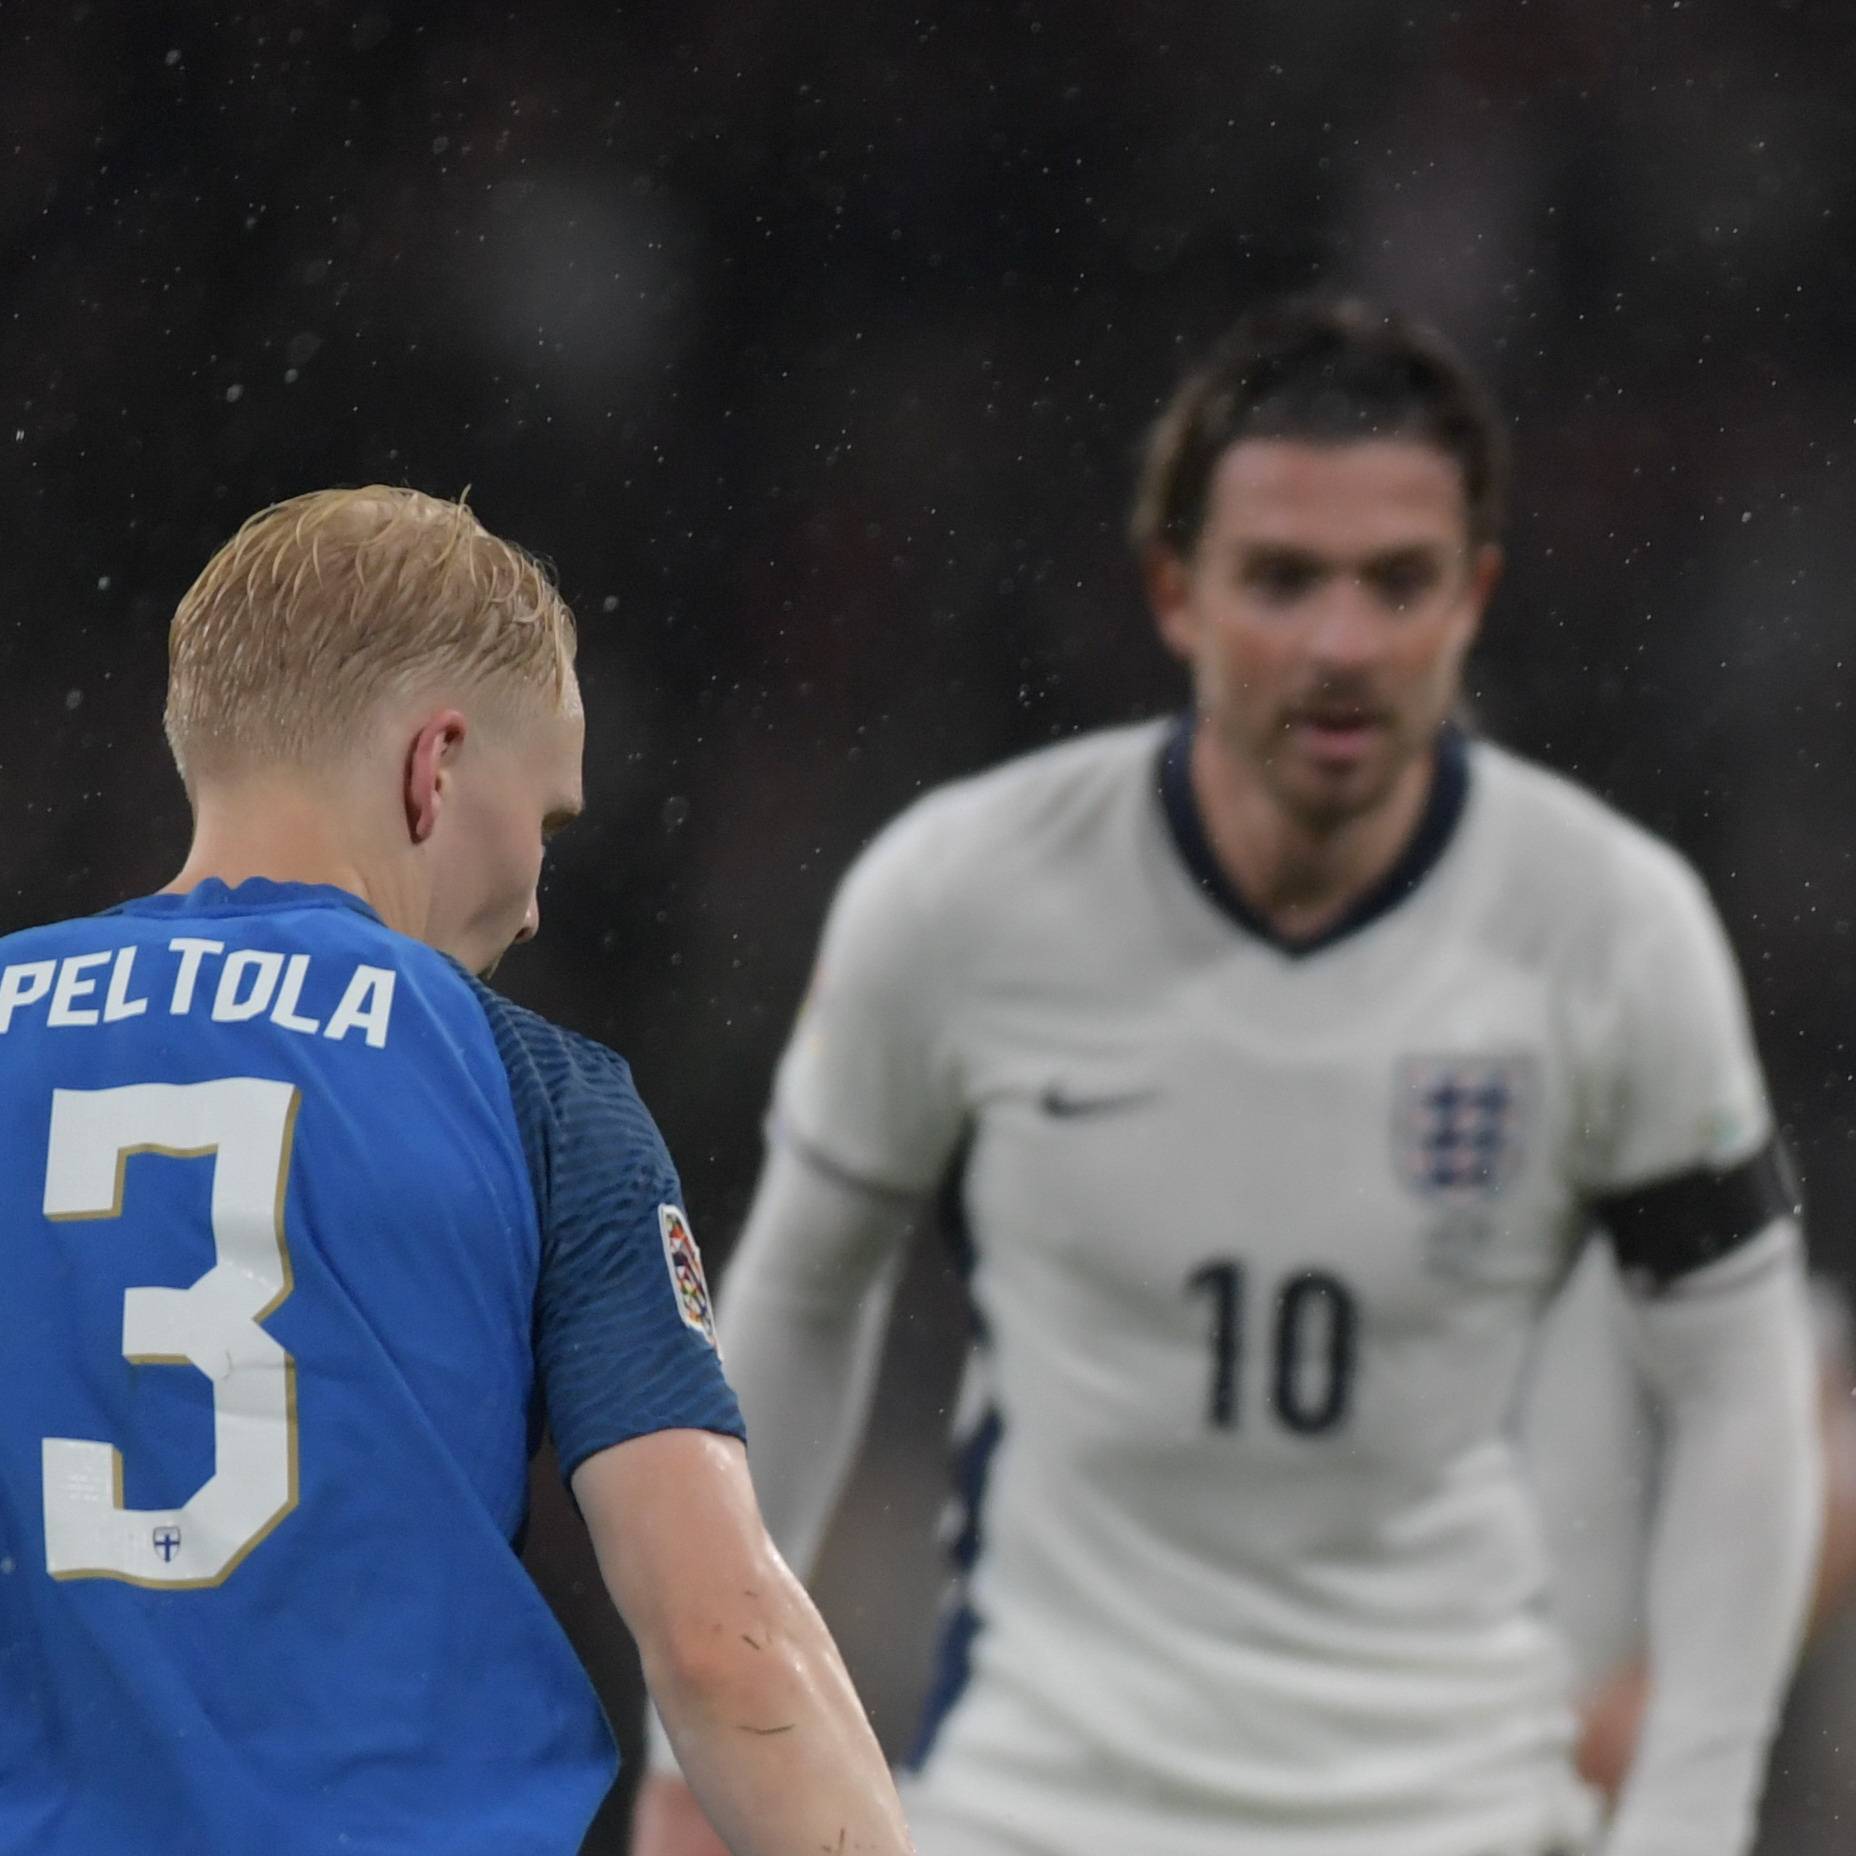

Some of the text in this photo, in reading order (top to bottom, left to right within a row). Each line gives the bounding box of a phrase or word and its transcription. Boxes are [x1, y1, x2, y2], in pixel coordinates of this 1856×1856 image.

[0, 937, 397, 1049] PELTOLA
[42, 1077, 300, 1588] 3
[1182, 1257, 1359, 1440] 10
